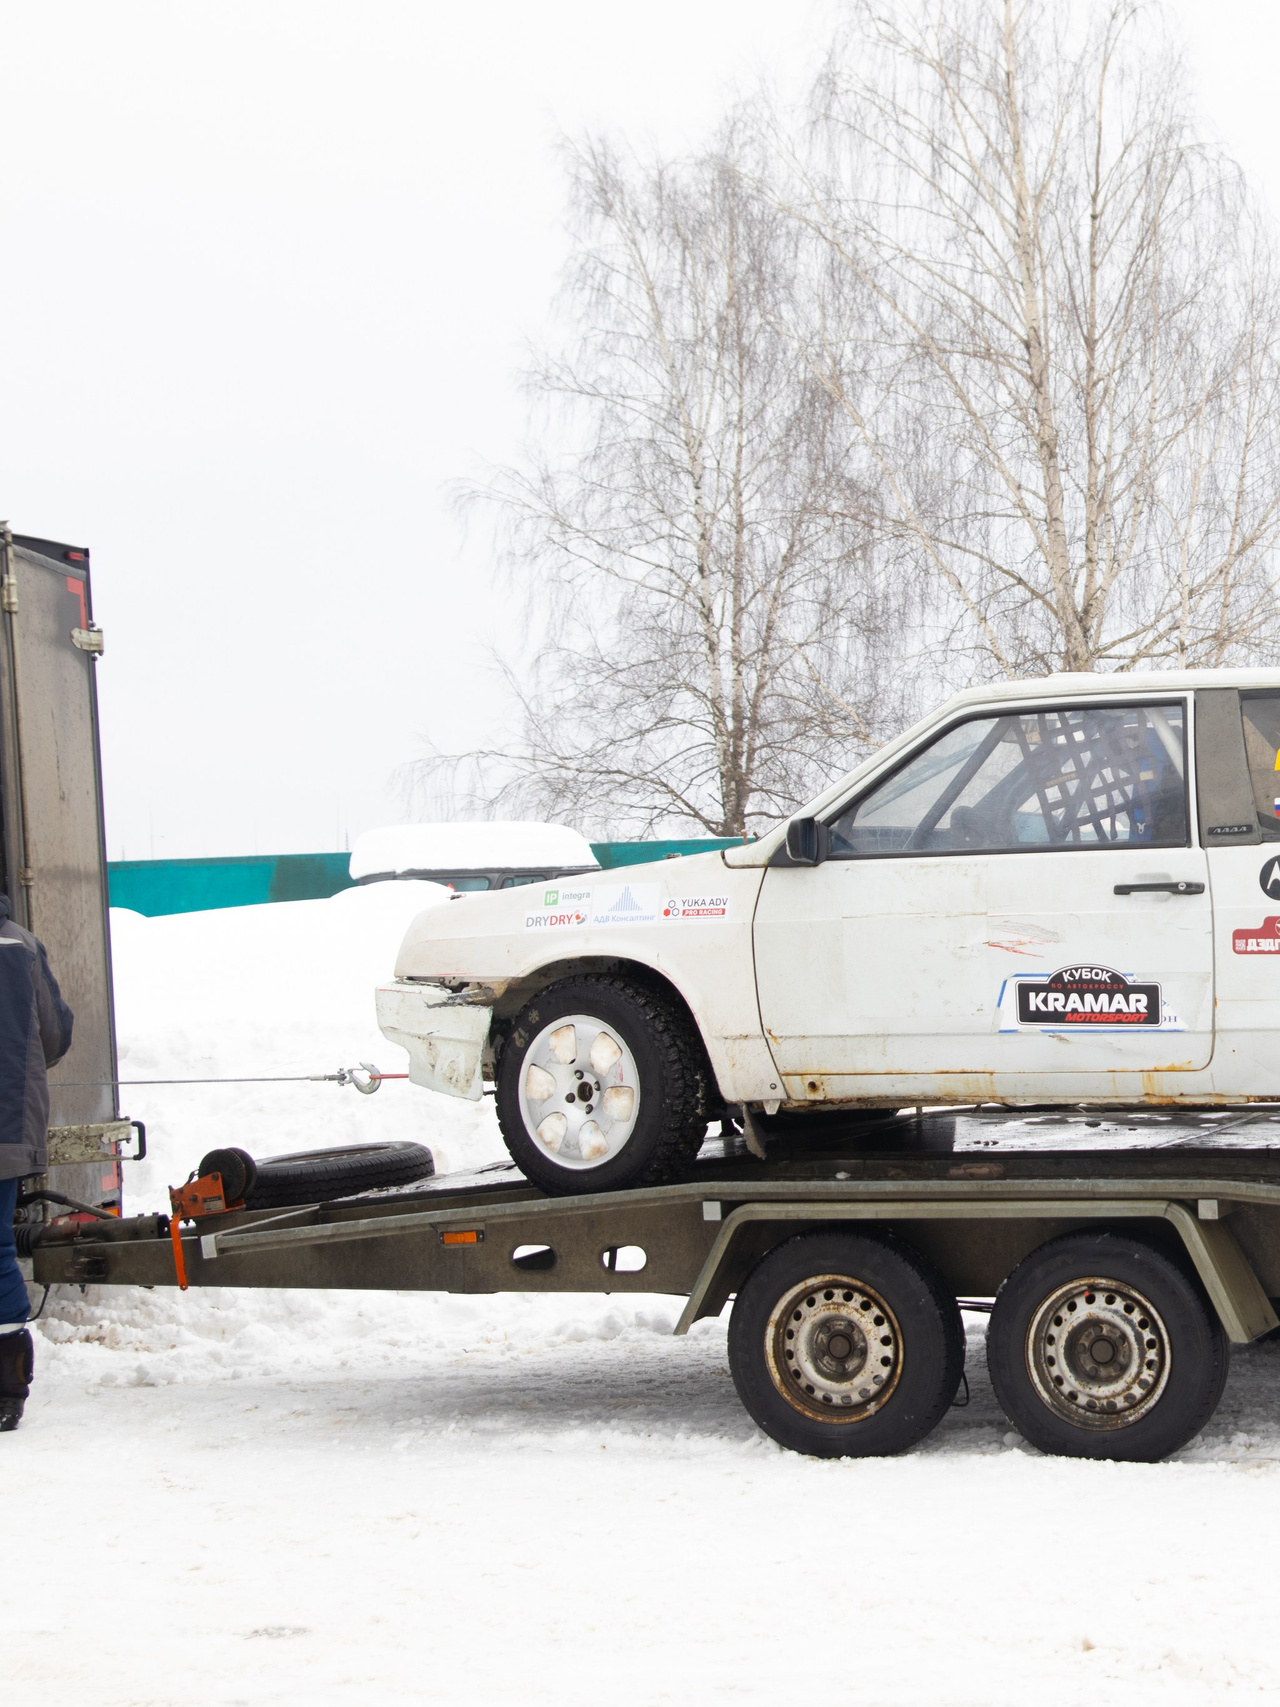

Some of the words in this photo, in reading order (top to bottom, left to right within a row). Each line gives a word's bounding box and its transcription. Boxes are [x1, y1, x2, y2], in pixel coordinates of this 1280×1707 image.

[562, 892, 590, 901] integra
[682, 899, 706, 907] YUKA
[708, 898, 729, 906] ADV
[1062, 968, 1113, 983] КУБОК
[1028, 992, 1148, 1013] KRAMAR
[1065, 1013, 1148, 1022] MOTORSPORT
